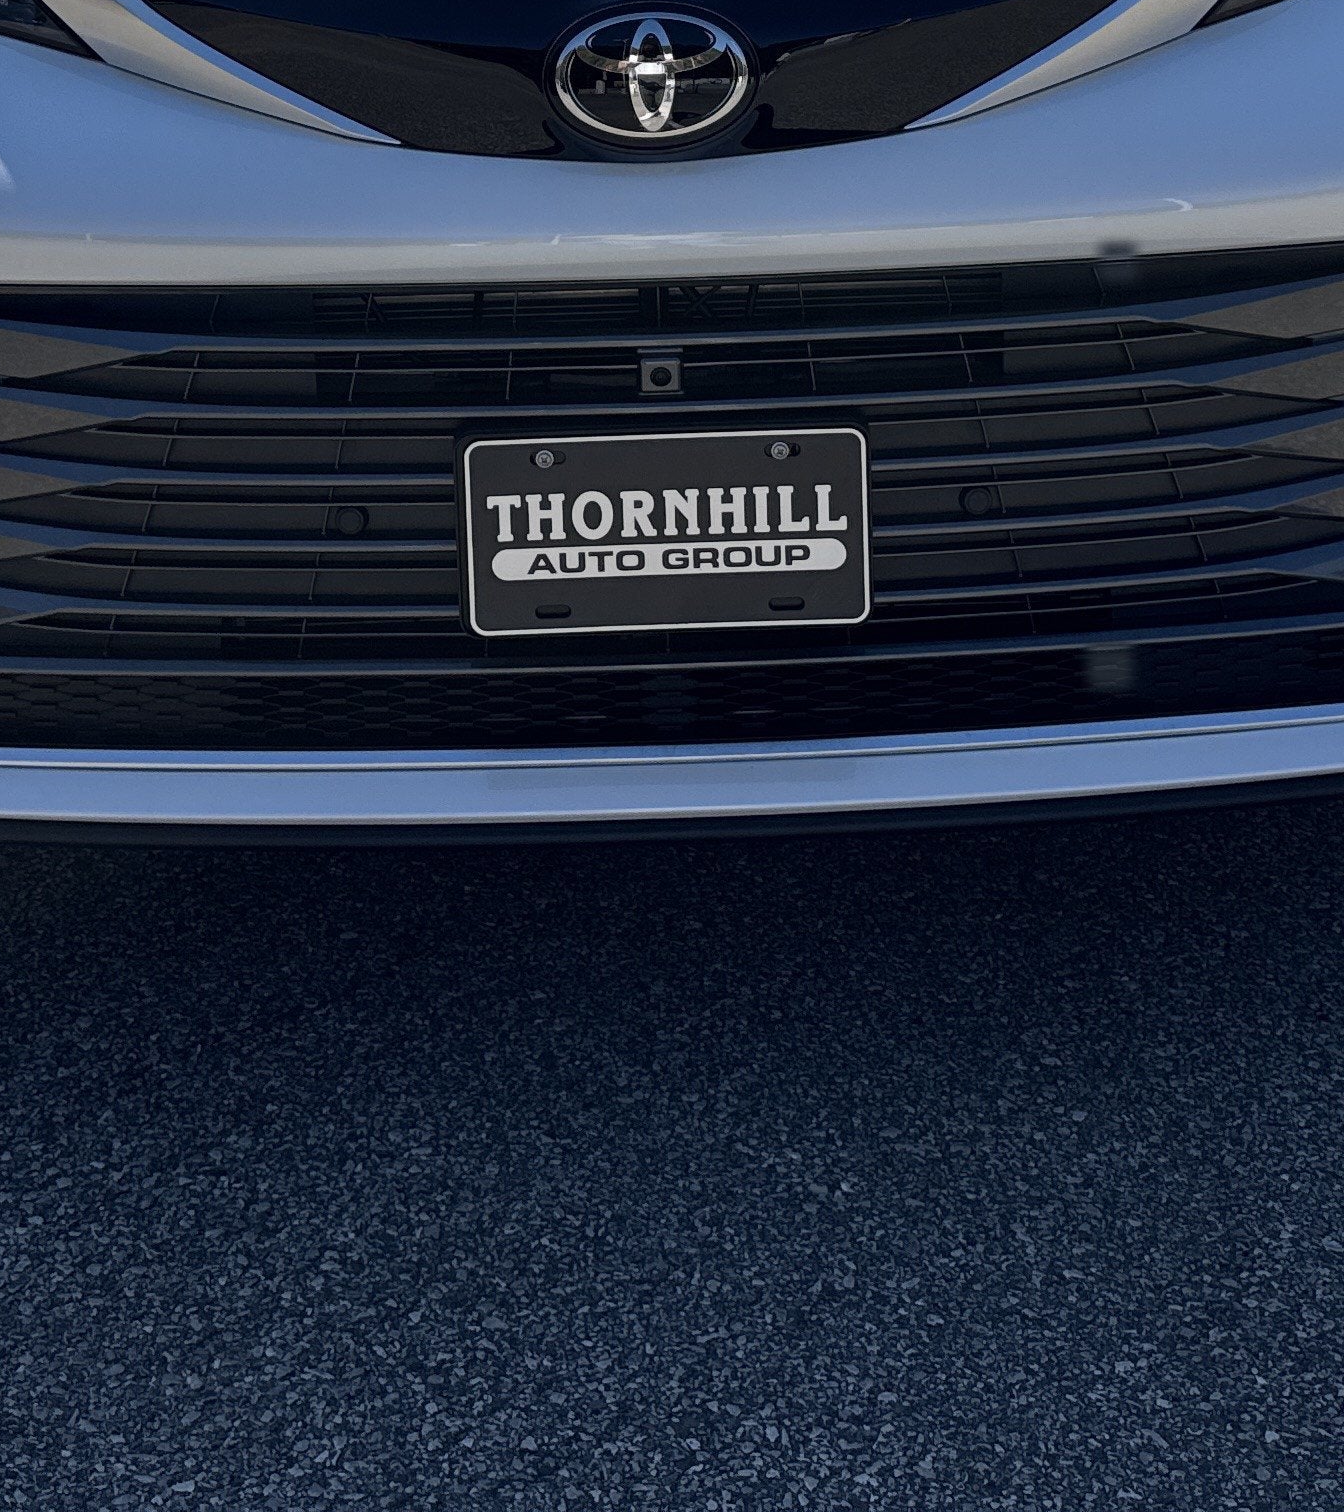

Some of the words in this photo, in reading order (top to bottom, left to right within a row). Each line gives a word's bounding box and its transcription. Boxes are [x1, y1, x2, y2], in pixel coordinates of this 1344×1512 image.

[487, 484, 847, 542] THORNHILL
[527, 550, 645, 574] AUTO
[661, 544, 811, 569] GROUP
